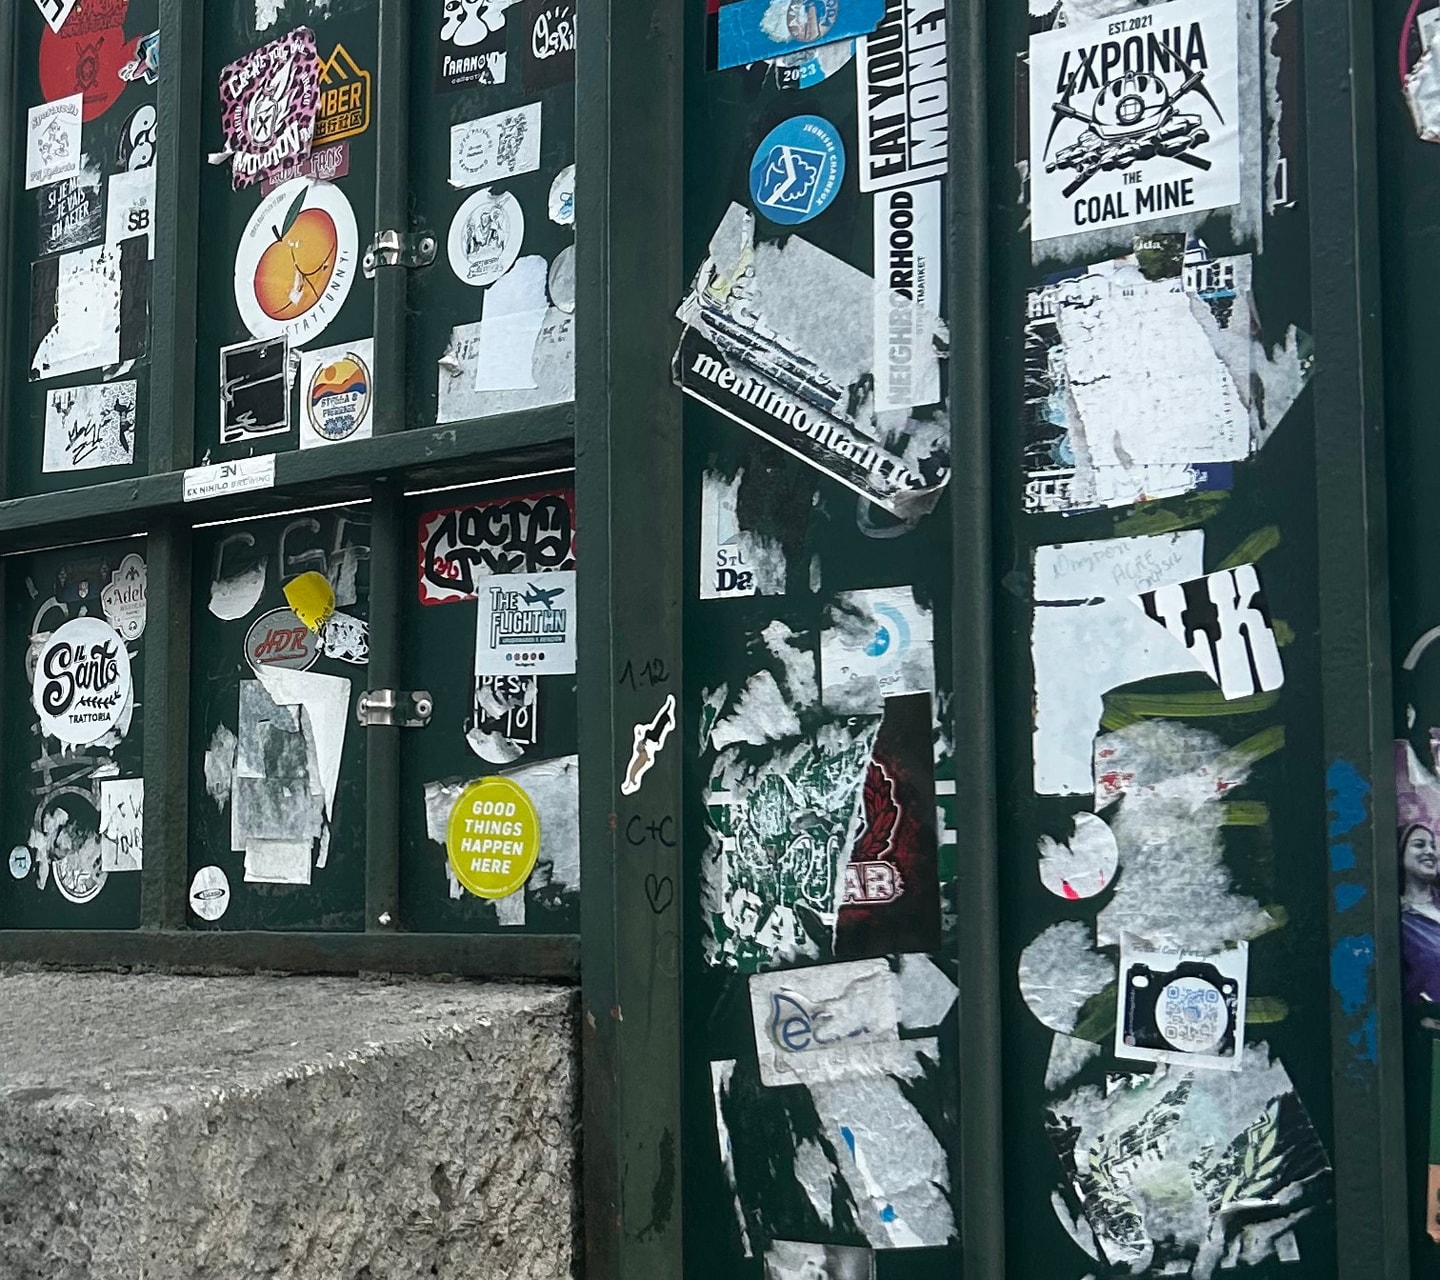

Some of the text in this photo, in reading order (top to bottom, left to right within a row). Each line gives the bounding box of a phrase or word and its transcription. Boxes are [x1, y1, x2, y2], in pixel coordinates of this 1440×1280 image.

[1108, 14, 1153, 36] EST.2021
[782, 64, 817, 83] 2023
[803, 123, 835, 153] JEUNESSE
[868, 114, 907, 181] EAT
[309, 145, 344, 174] FANS
[1122, 170, 1143, 185] THE
[1073, 176, 1195, 226] COAL MINE
[127, 209, 150, 232] SB
[199, 481, 230, 496] NIHILO
[490, 586, 519, 613] THE
[41, 640, 120, 716] Santo
[68, 712, 113, 725] TRATTORIA
[472, 799, 516, 818] GOOD
[463, 818, 524, 838] THINGS
[625, 815, 677, 849] C+C
[460, 837, 526, 857] HAPPEN
[470, 856, 512, 876] HERE
